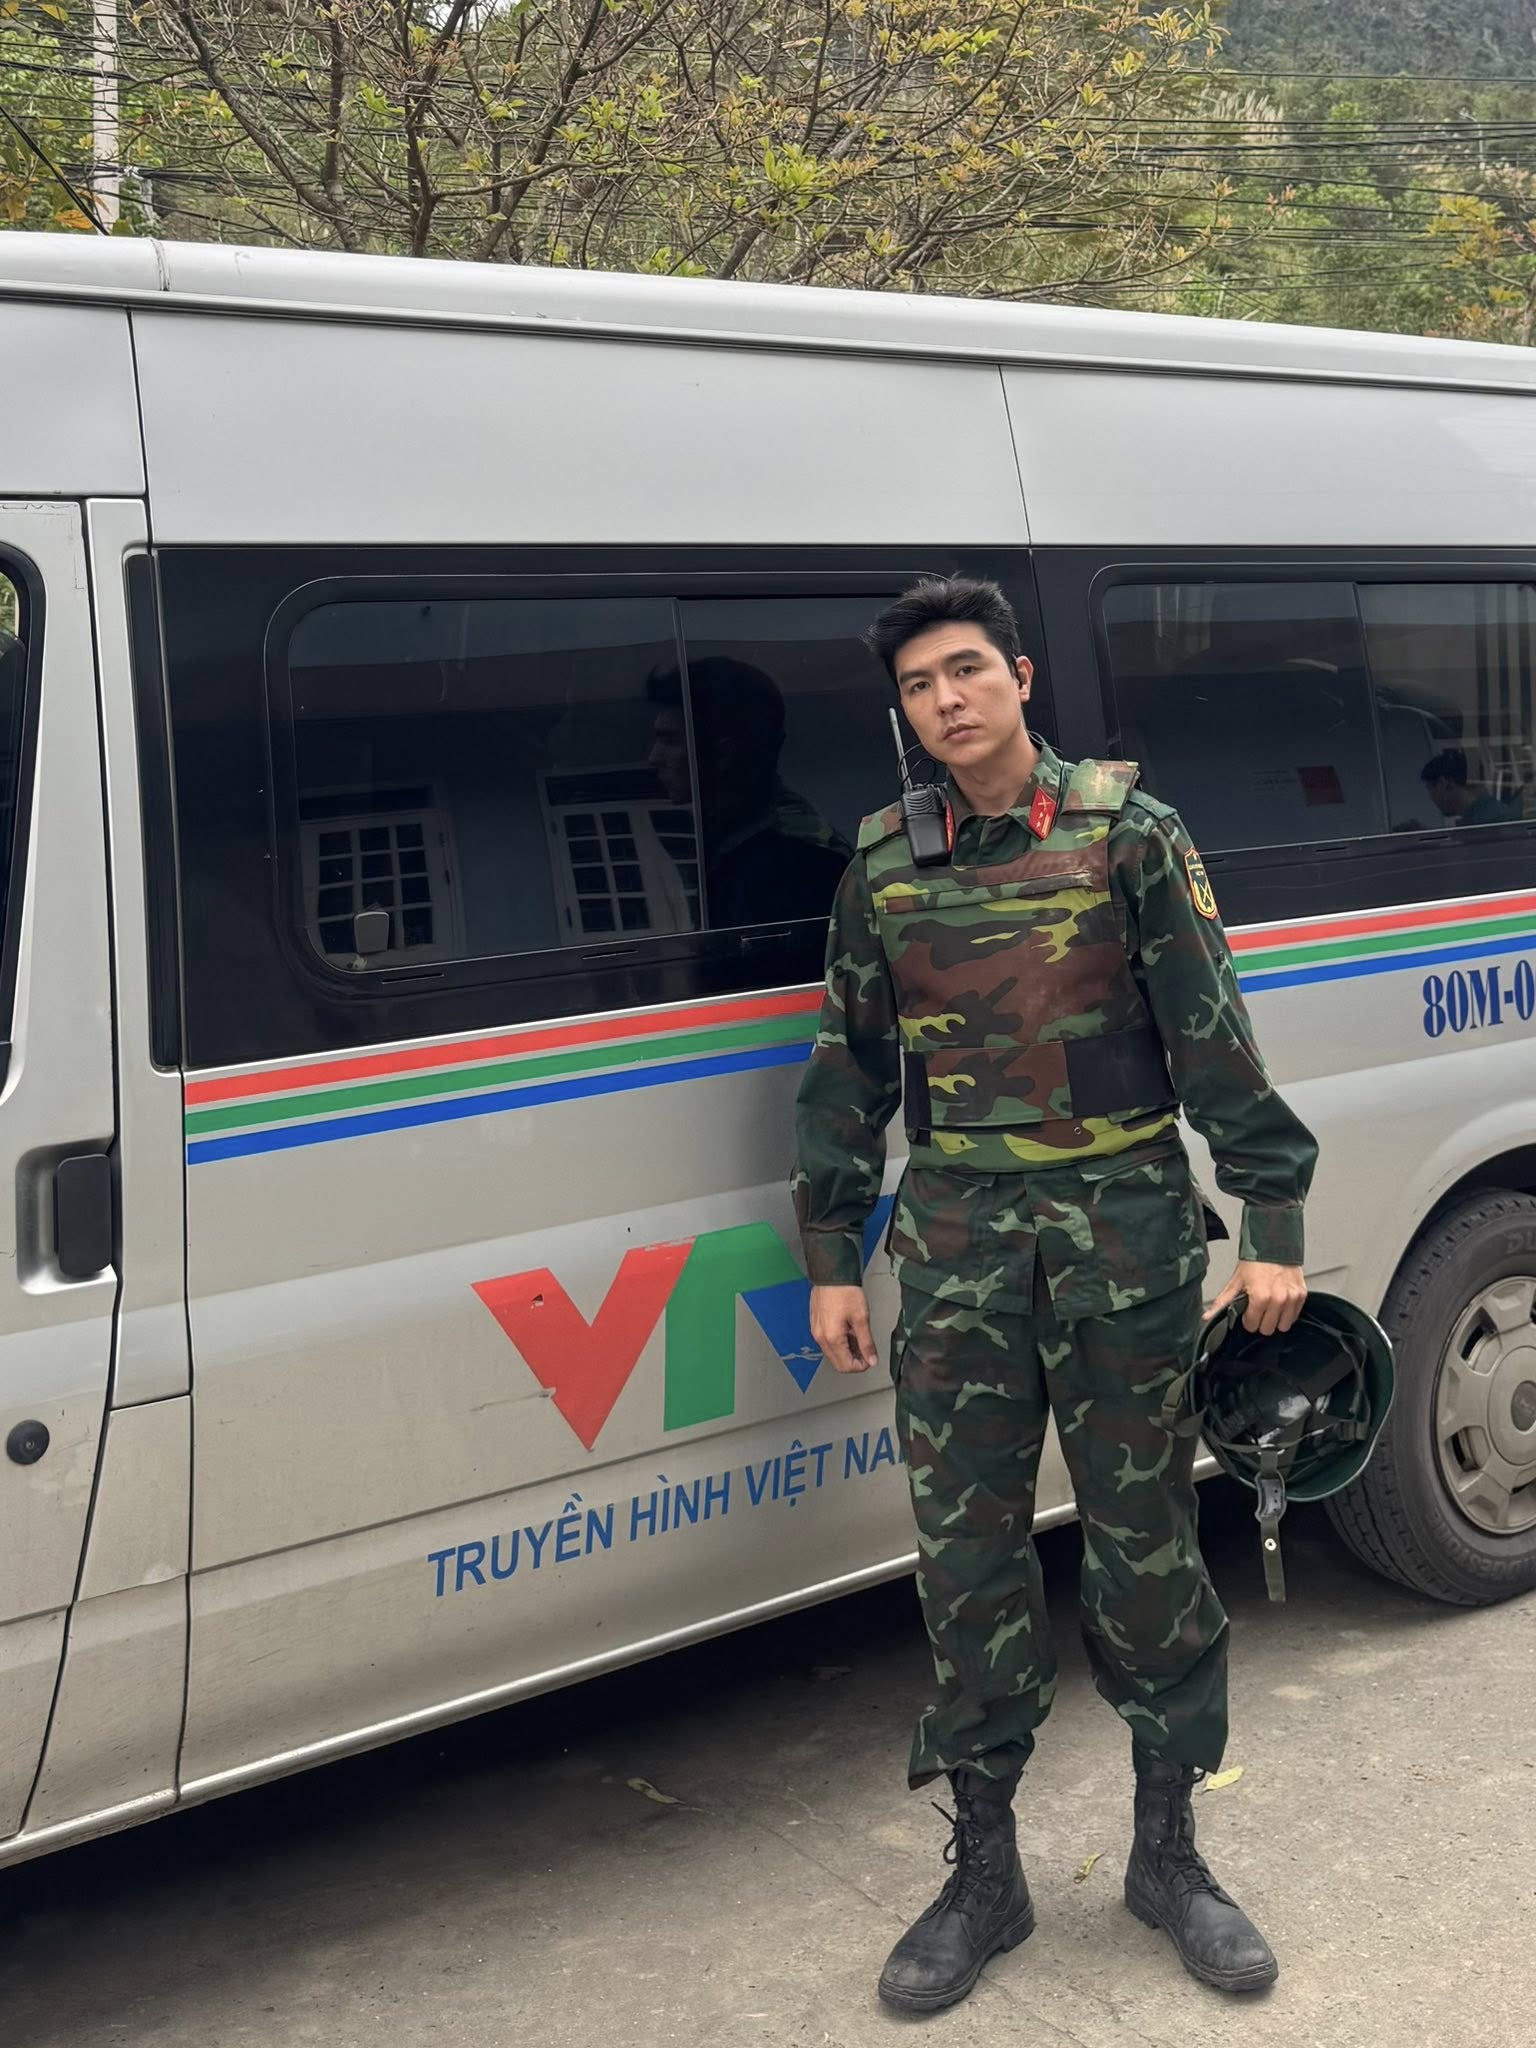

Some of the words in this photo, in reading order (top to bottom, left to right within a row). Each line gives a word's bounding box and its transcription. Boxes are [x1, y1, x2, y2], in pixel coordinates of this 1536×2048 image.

[1422, 960, 1536, 1038] 80M-0
[427, 1492, 614, 1597] TRUYỀN
[629, 1474, 731, 1541] HÌNH
[745, 1439, 833, 1507] VIỆT
[843, 1426, 904, 1480] NA
